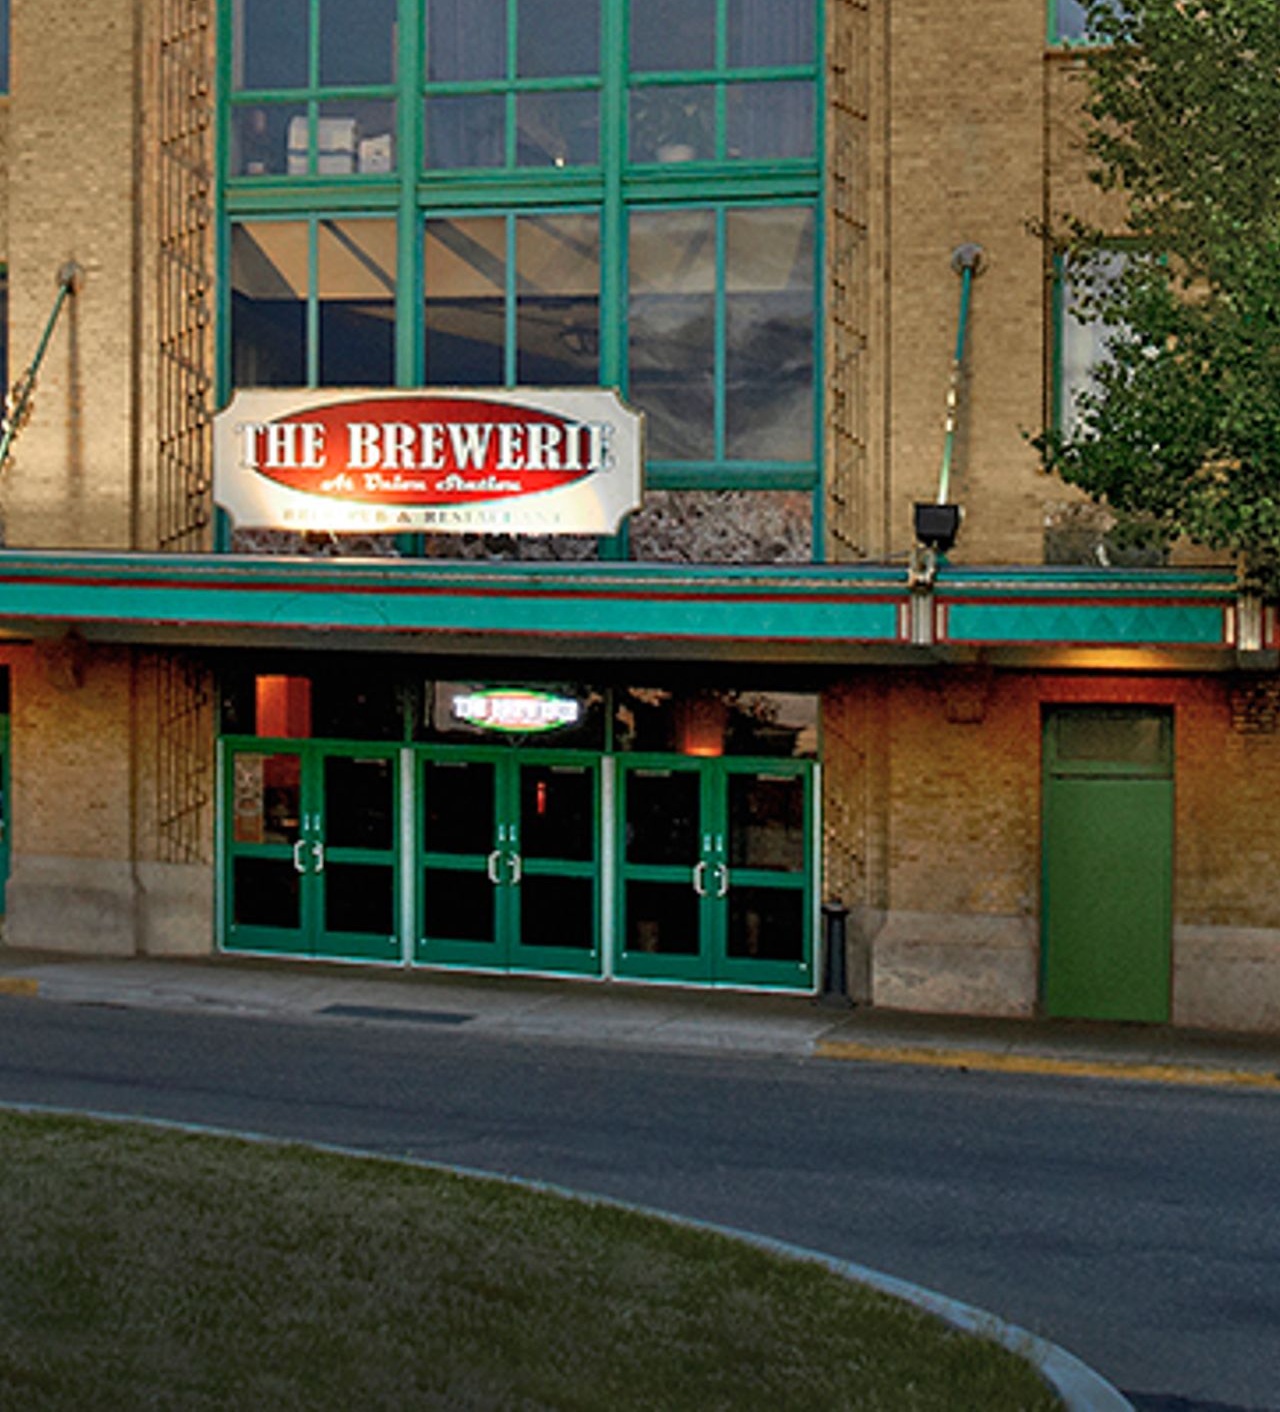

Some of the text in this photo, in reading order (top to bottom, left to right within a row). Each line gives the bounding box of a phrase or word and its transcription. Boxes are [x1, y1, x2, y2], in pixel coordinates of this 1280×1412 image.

[234, 421, 617, 473] THE BREWERIE
[321, 472, 523, 493] At Union Station
